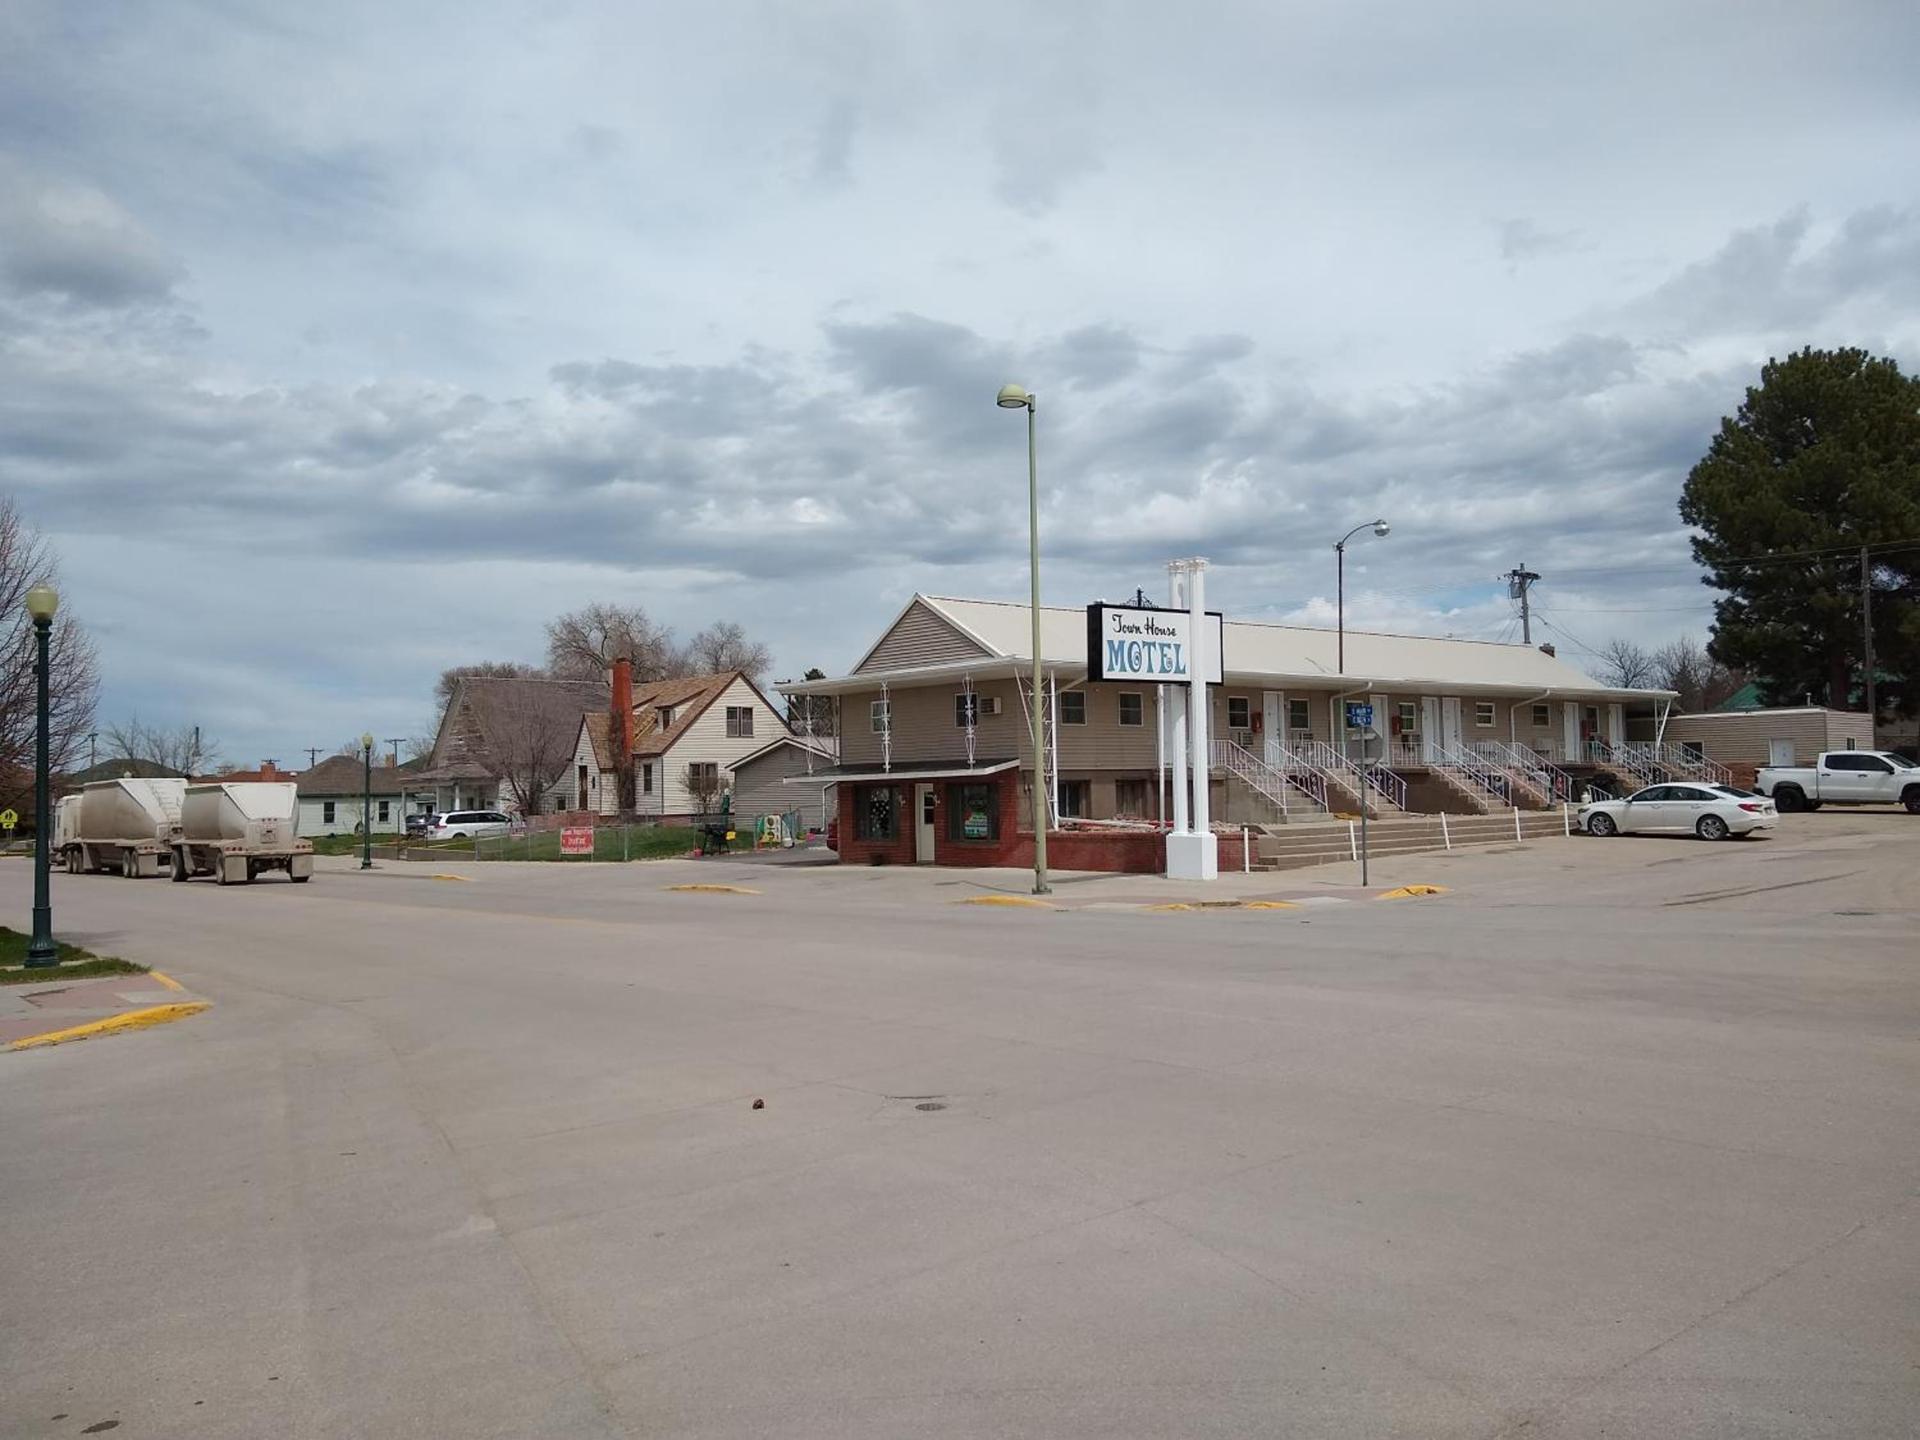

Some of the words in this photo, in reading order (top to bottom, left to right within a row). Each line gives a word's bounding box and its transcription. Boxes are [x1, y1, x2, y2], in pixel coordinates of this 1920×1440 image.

[1112, 614, 1143, 635] Town
[1144, 616, 1177, 637] House
[1106, 639, 1186, 675] MOTEL
